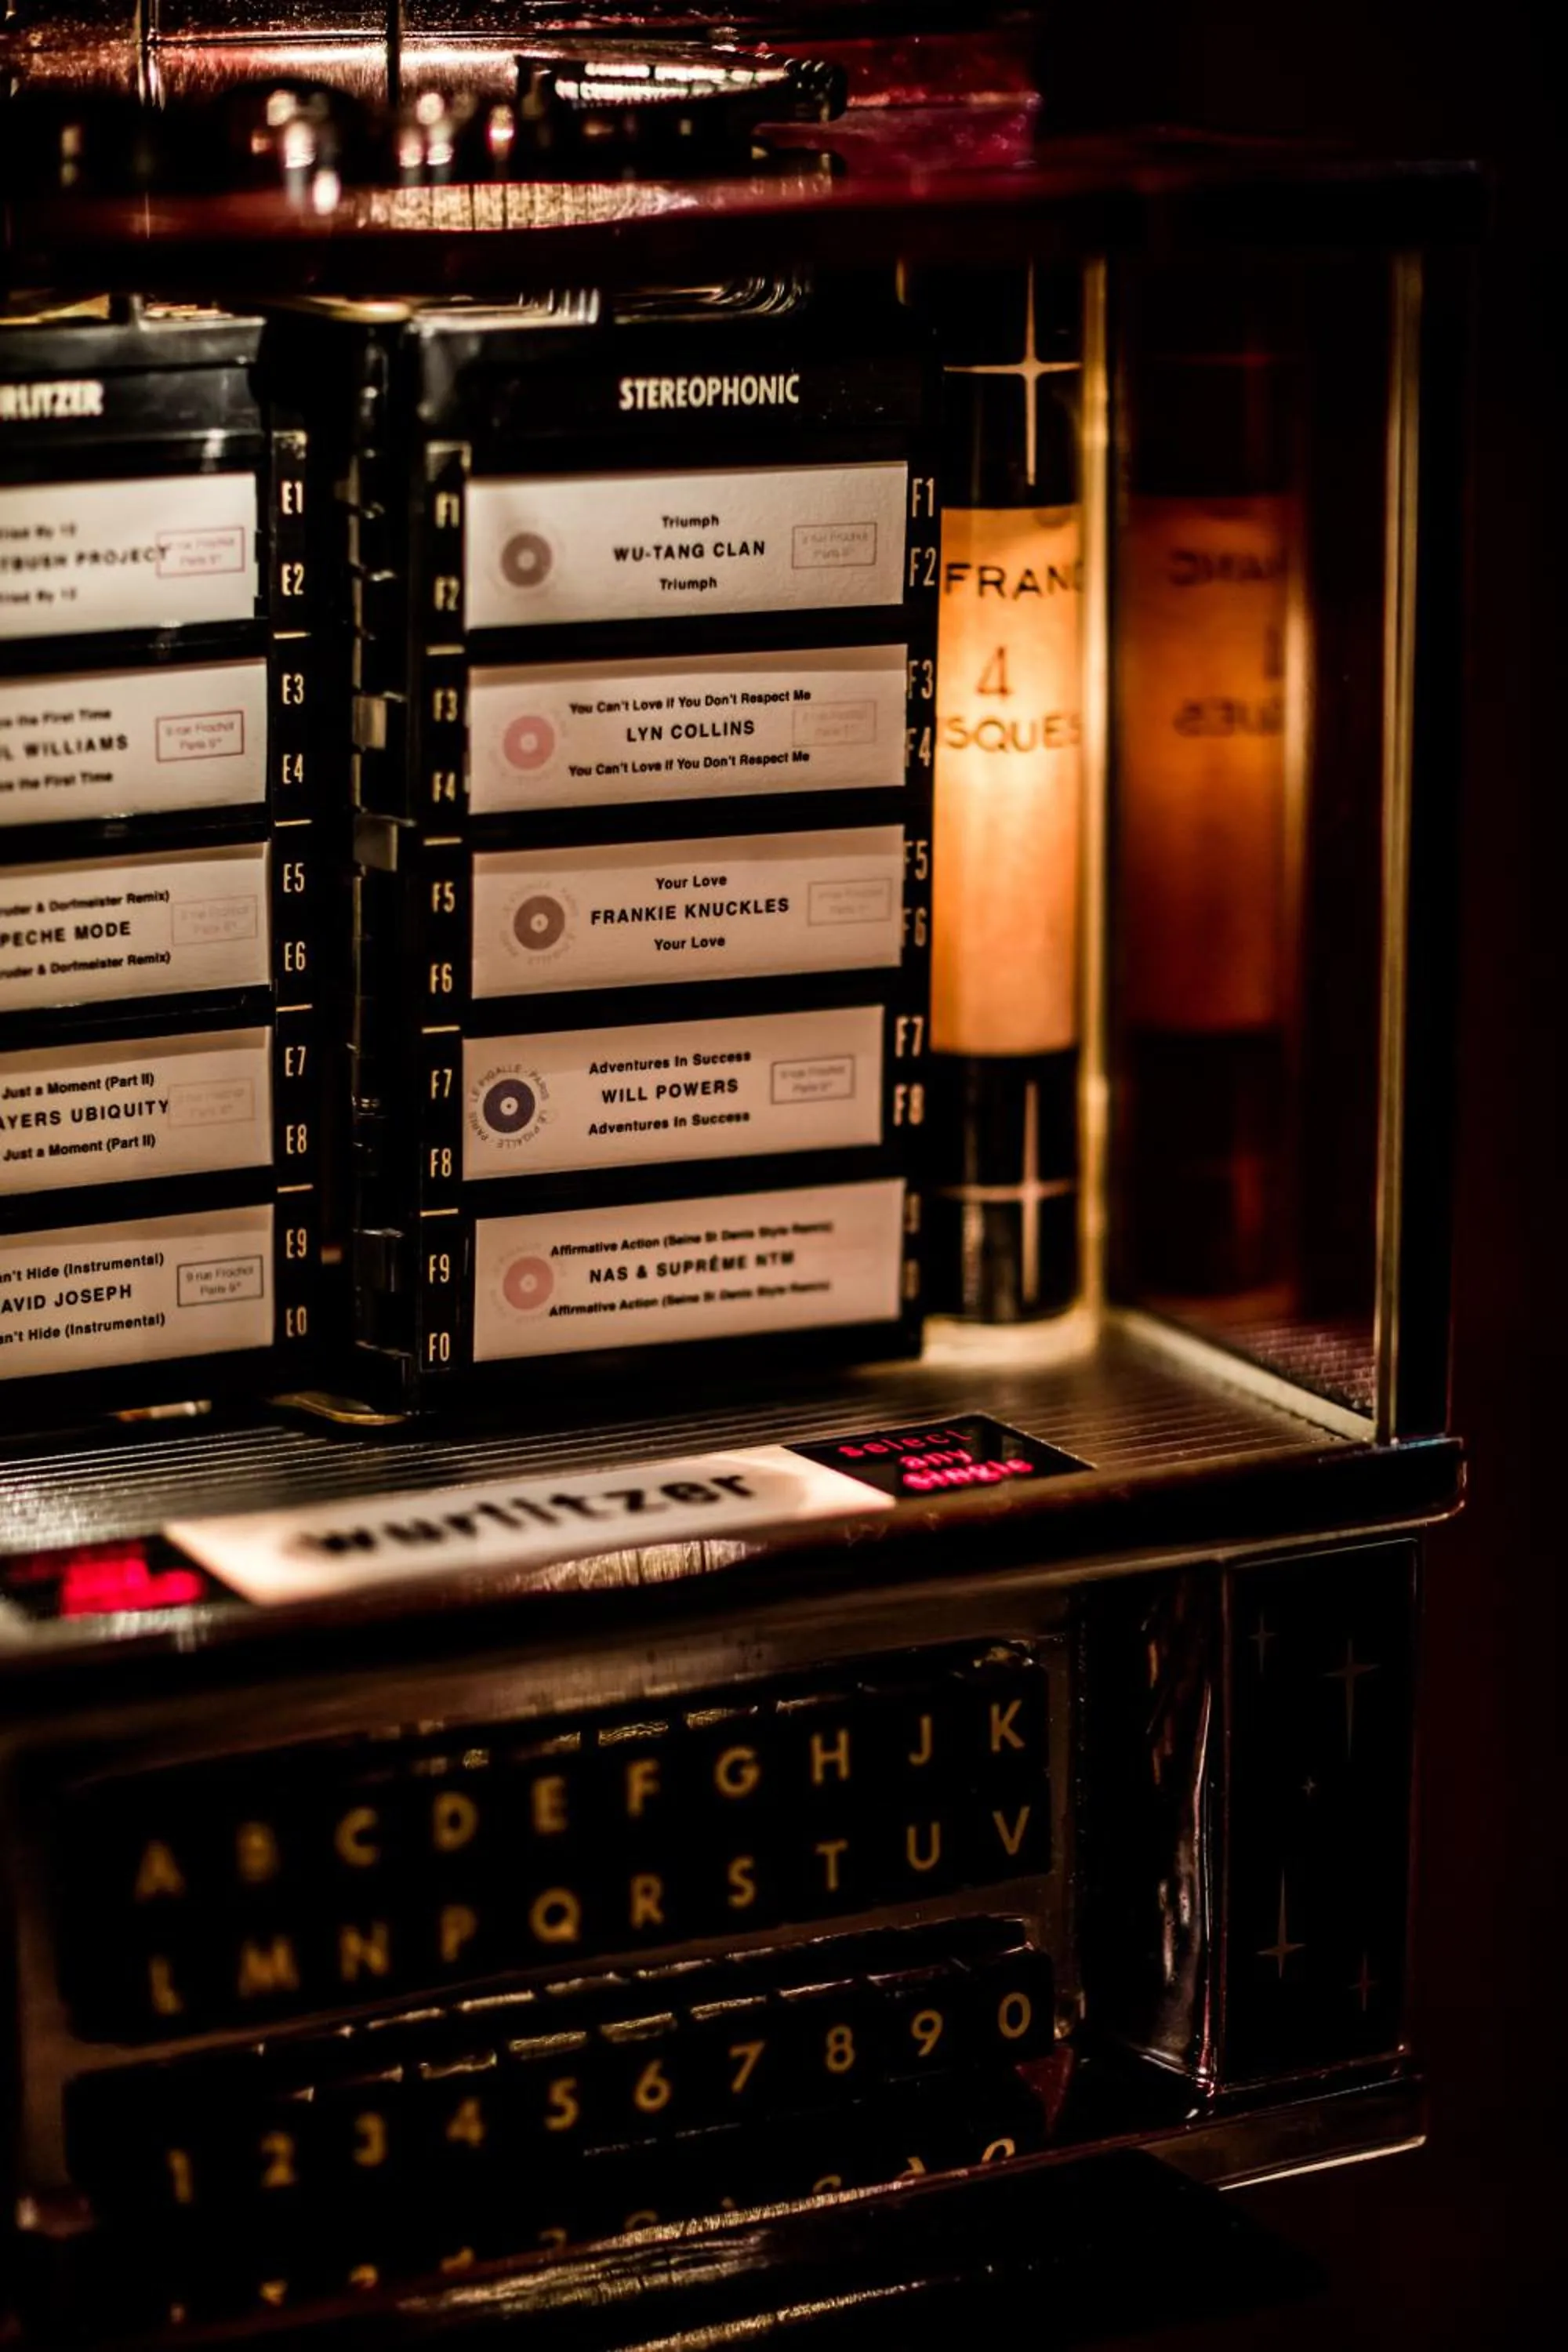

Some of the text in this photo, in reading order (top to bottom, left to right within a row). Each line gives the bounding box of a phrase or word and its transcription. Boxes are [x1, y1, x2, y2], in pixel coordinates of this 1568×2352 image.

[619, 374, 800, 410] STEREOPHONIC
[281, 481, 303, 514] E1
[435, 491, 459, 529] F1
[912, 477, 934, 517] F1
[662, 514, 720, 529] Triumph
[76, 544, 170, 565] PROJECT
[614, 540, 765, 562] WU-TANG CLAN
[281, 562, 304, 596] E2
[909, 547, 936, 586] F2
[434, 575, 459, 612] F2
[659, 576, 718, 592] Triumph
[908, 659, 933, 699] F3
[975, 644, 1013, 701] 4
[282, 673, 303, 704] E3
[569, 702, 593, 714] You
[597, 700, 629, 713] Can't
[633, 699, 662, 711] Love
[678, 696, 701, 708] You
[706, 693, 736, 706] Don't
[741, 691, 789, 705] Respect
[793, 689, 811, 702] Me
[434, 688, 458, 722] F3
[24, 733, 128, 758] WILLIAMS
[627, 720, 754, 742] LYN COLLINS
[906, 727, 931, 768] F4
[283, 753, 303, 784] E4
[568, 765, 592, 777] You
[596, 761, 628, 775] Can't
[632, 760, 662, 773] Love
[677, 757, 699, 771] You
[703, 755, 735, 768] Don't
[740, 753, 788, 768] Respect
[792, 750, 810, 763] Me
[433, 771, 456, 803] F4
[283, 862, 305, 892] E5
[655, 875, 728, 890] Your Love
[126, 890, 169, 903] Remix)
[433, 881, 455, 913] F5
[590, 898, 789, 925] FRANKIE KNUCKLES
[0, 920, 131, 947] PECHE MODE
[654, 936, 725, 951] Your Love
[127, 951, 171, 965] Remix)
[285, 942, 306, 971] E6
[430, 963, 452, 994] F6
[896, 1016, 924, 1057] F7
[285, 1046, 307, 1077] E7
[589, 1051, 751, 1075] Adventures In Success
[2, 1086, 31, 1100] Just
[35, 1087, 43, 1096] a
[47, 1079, 101, 1094] Moment
[105, 1074, 138, 1091] (Part
[431, 1069, 452, 1099] F7
[602, 1079, 739, 1104] WILL POWERS
[71, 1099, 169, 1123] UBIQUITY
[589, 1112, 750, 1135] Adventures In Success
[3, 1148, 33, 1162] Just
[36, 1148, 45, 1158] a
[49, 1141, 103, 1156] Moment
[106, 1137, 139, 1153] (Part
[286, 1123, 307, 1155] E8
[430, 1148, 452, 1178] F8
[286, 1227, 307, 1259] E9
[550, 1237, 660, 1258] Affirmative Action
[27, 1267, 60, 1280] Hide
[64, 1252, 164, 1279] (Instrumental)
[430, 1254, 449, 1283] F9
[590, 1266, 628, 1283] NAS
[637, 1265, 648, 1279] &
[1, 1283, 132, 1314] AVID JOSEPH
[550, 1301, 615, 1317] Affirmative
[619, 1298, 658, 1311] Action
[28, 1327, 60, 1341] Hide
[65, 1312, 165, 1340] (Instrumental)
[286, 1305, 307, 1338] E0
[429, 1332, 450, 1362] F0
[133, 1839, 186, 1902] A
[335, 1806, 379, 1867] C
[434, 1791, 478, 1852] D
[532, 1775, 567, 1835] E
[628, 1758, 659, 1817] F
[714, 1746, 760, 1798] G
[810, 1729, 850, 1787] H
[909, 1715, 932, 1766] J
[990, 1700, 1025, 1753] K
[148, 1806, 1029, 2015] L M N P Q R S T U V
[167, 1991, 1031, 2203] 1 2 3 4 5 6 7 8 9 0
